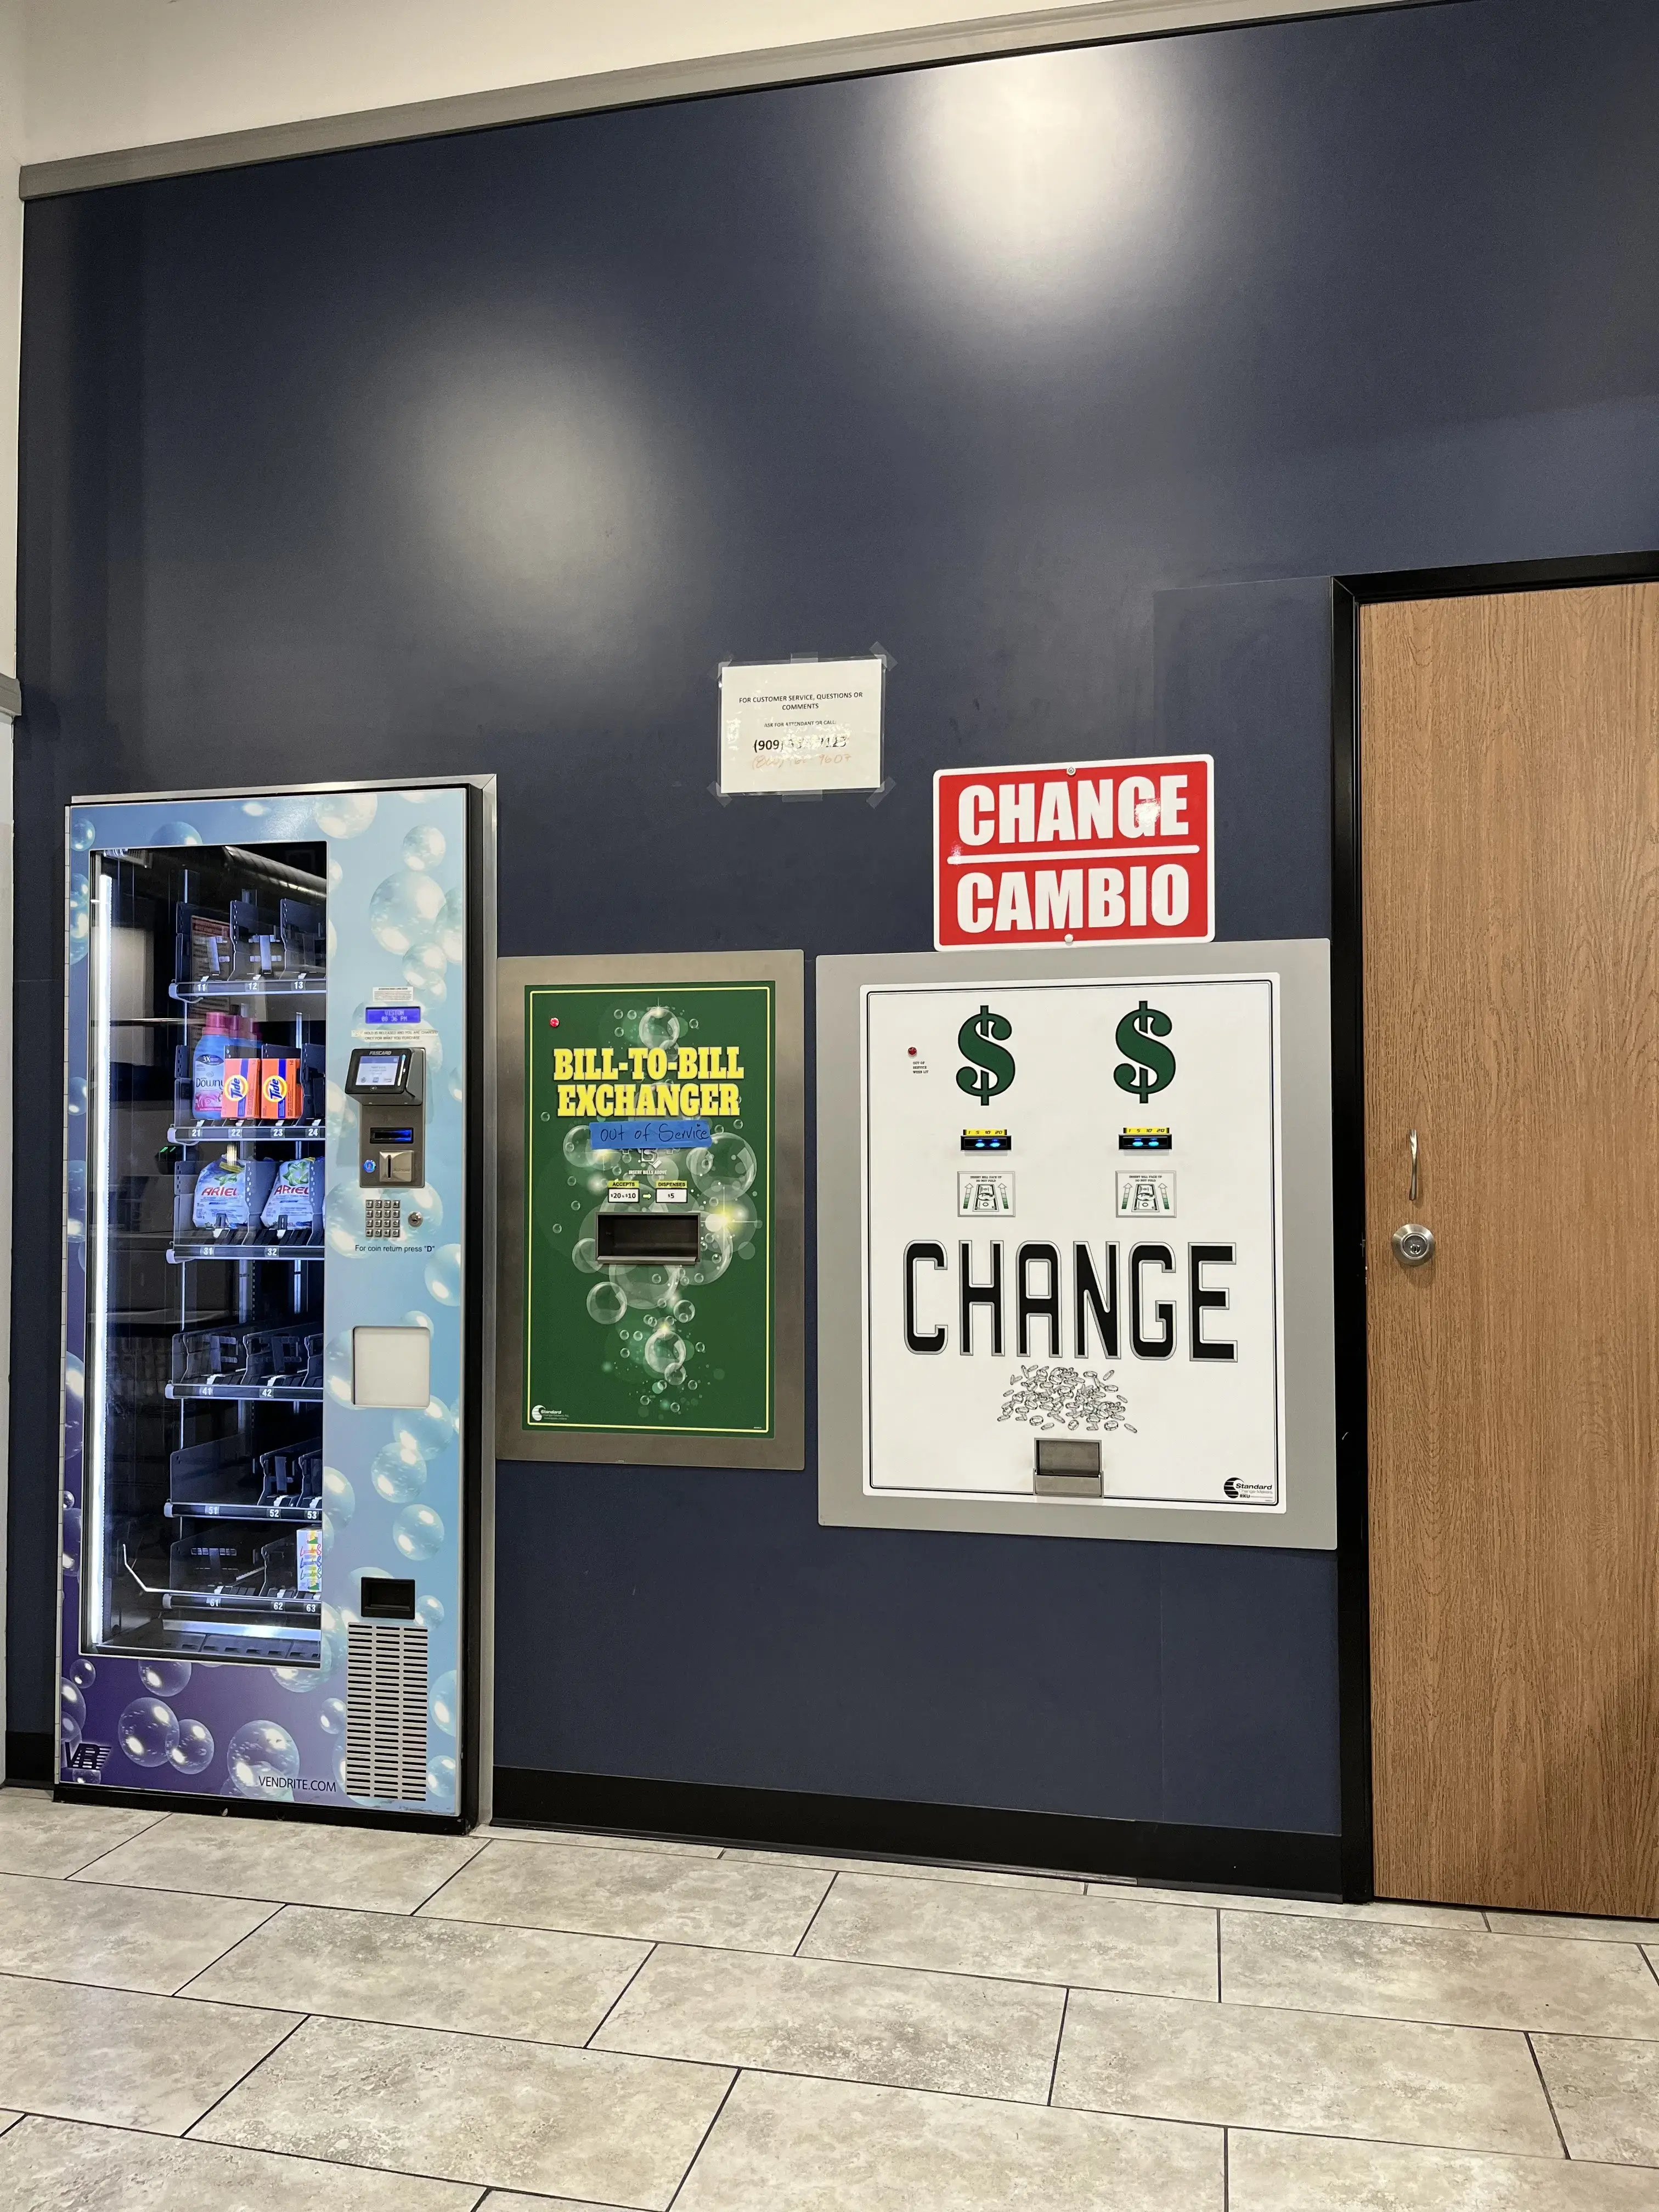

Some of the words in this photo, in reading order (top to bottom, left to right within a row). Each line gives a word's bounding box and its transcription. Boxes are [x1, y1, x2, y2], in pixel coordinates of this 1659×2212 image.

[958, 774, 1189, 846] CHANGE
[957, 864, 1189, 933] CAMBIO
[554, 1046, 744, 1081] BILL-TO-BILL
[230, 1077, 243, 1098] Tide
[269, 1079, 283, 1099] Tide
[557, 1083, 740, 1116] EXCHANGER
[634, 1123, 651, 1141] of
[201, 1187, 239, 1196] ARIEL
[274, 1184, 309, 1195] ARIEL
[903, 1240, 1238, 1362] CHANGE
[262, 1389, 272, 1397] 42
[269, 1509, 279, 1517] 52
[307, 1511, 317, 1519] 53
[210, 1598, 218, 1606] 61
[274, 1602, 283, 1610] 62
[306, 1604, 316, 1612] 63
[258, 1776, 336, 1792] VENDRITE.COM
